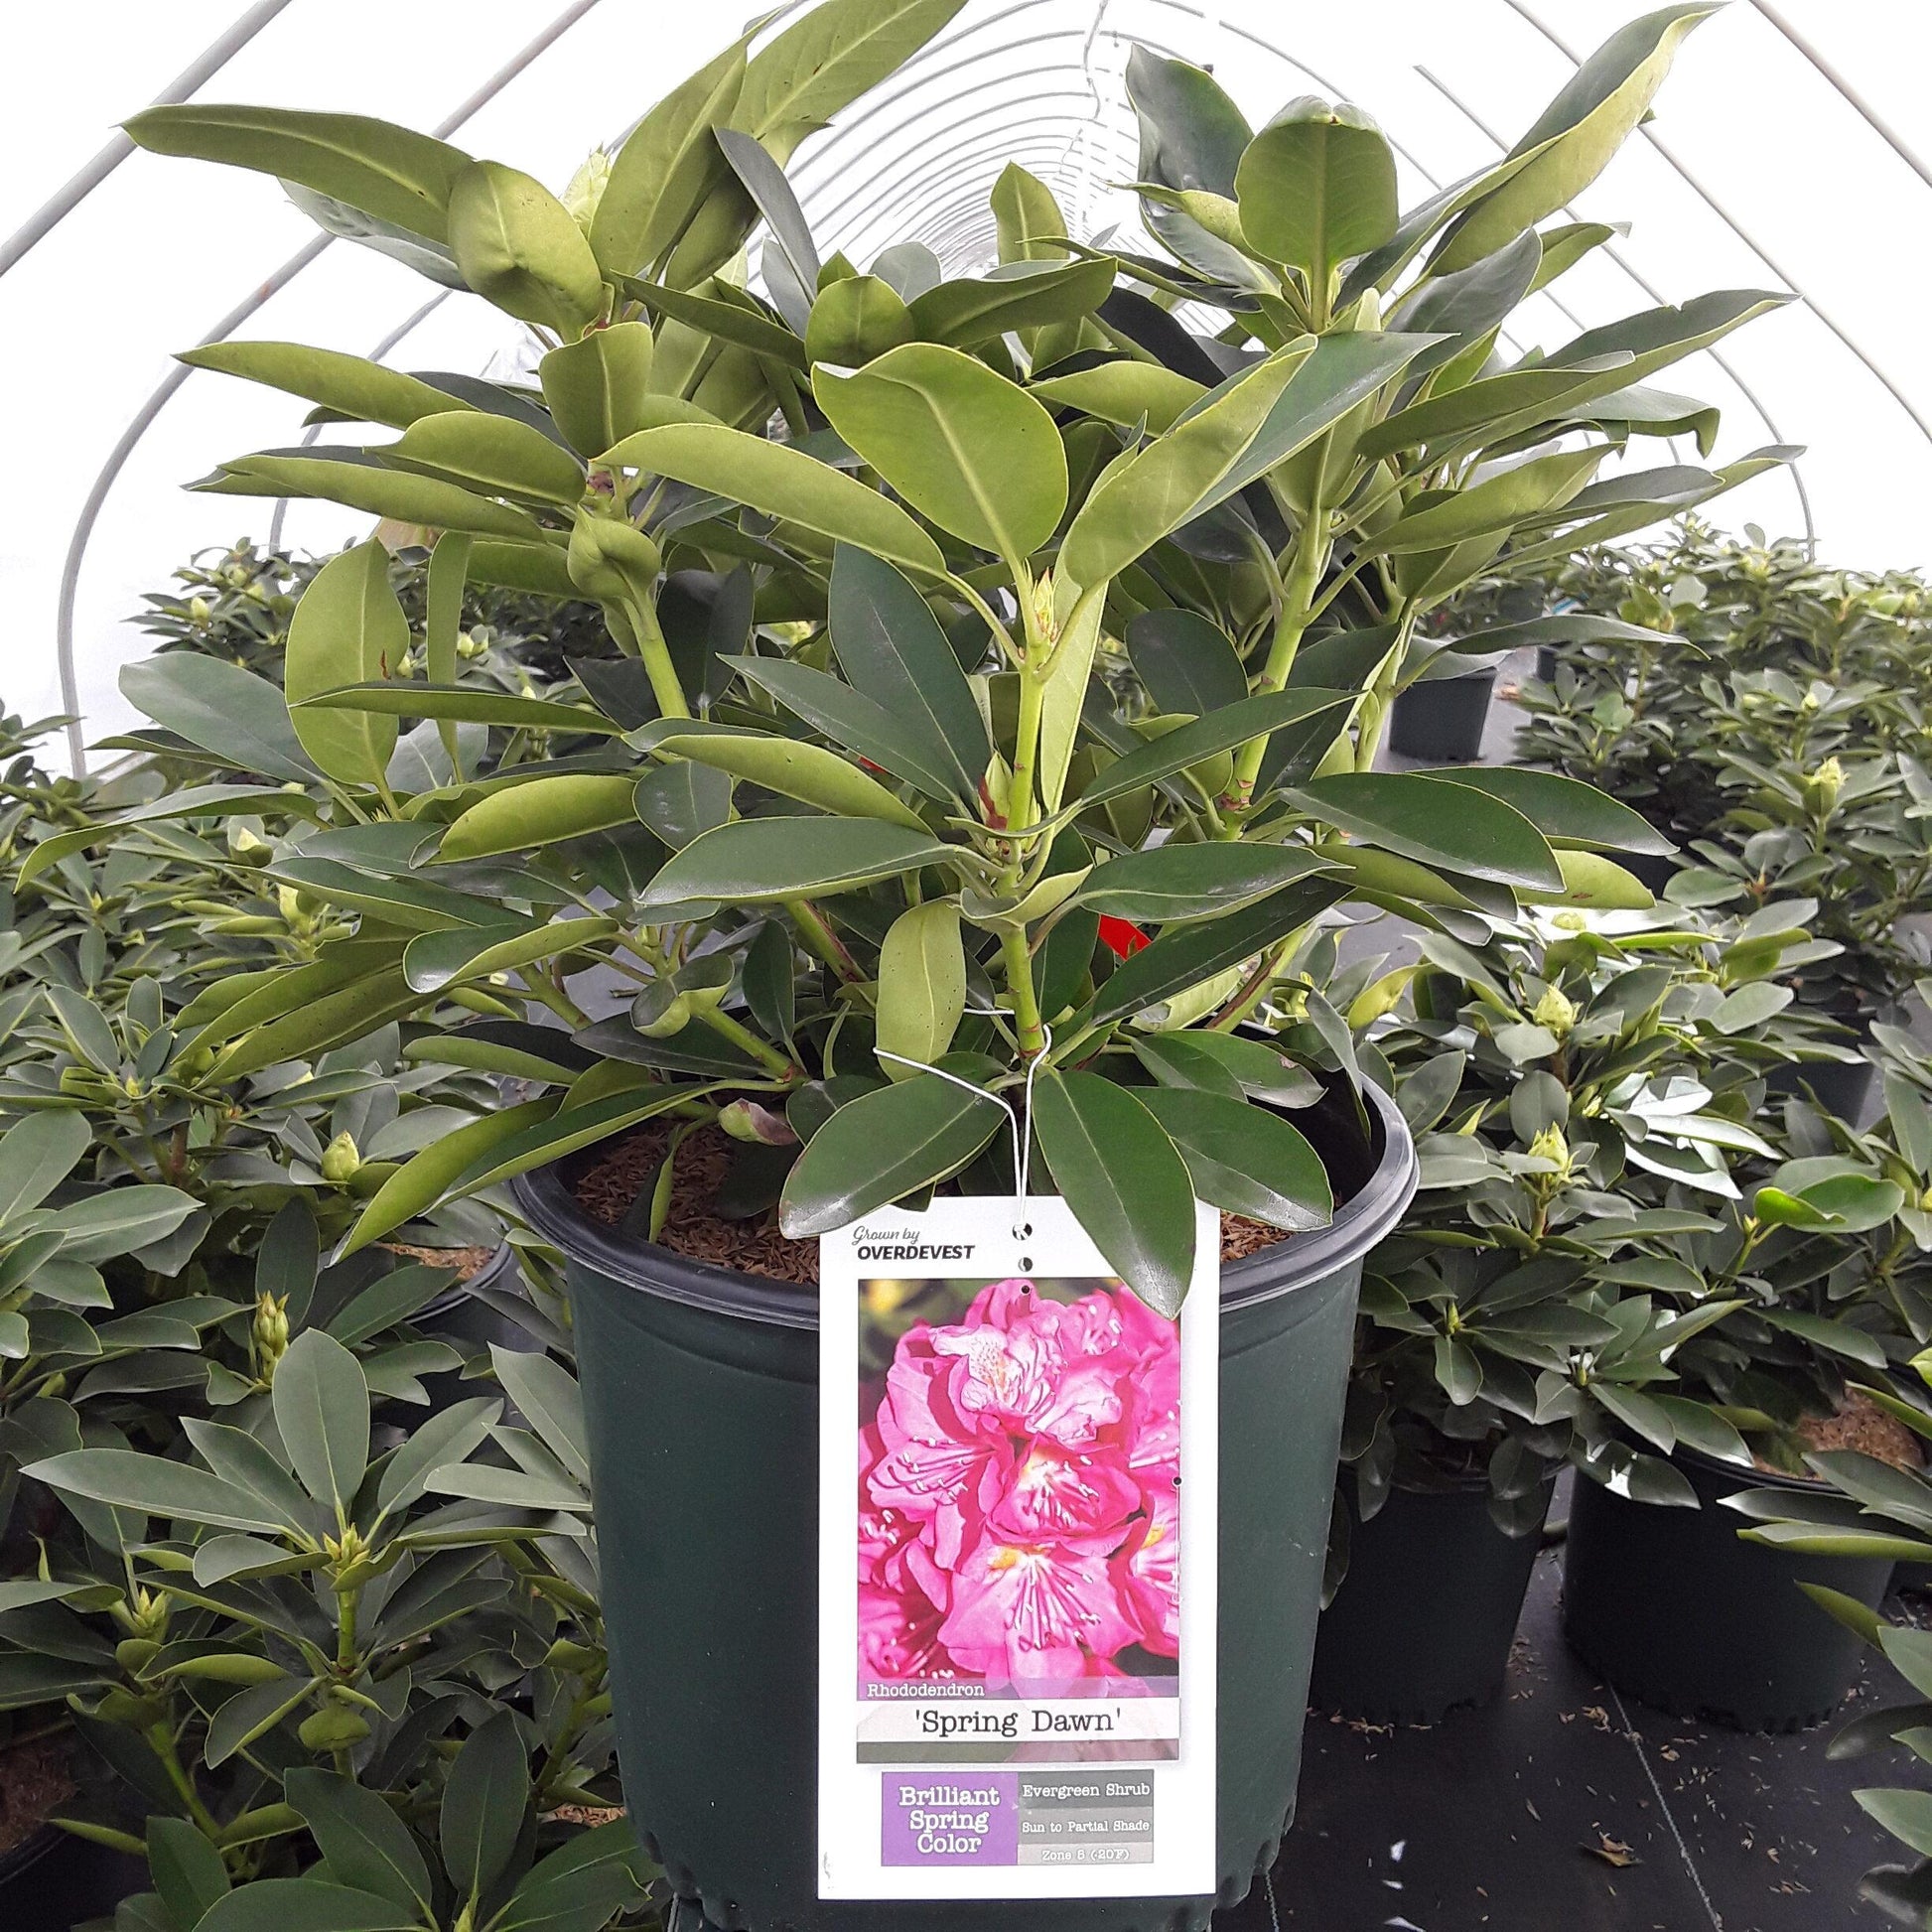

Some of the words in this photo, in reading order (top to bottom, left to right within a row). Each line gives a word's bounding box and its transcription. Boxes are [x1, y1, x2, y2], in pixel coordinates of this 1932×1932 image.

[852, 1225, 899, 1245] Grown
[902, 1227, 920, 1245] by
[857, 1245, 975, 1260] OVERDEVEST
[867, 1683, 985, 1698] Rhododendron
[915, 1709, 1019, 1737] 'Spring
[1032, 1707, 1121, 1732] Dawn'
[898, 1786, 1001, 1807] Brilliant
[1022, 1785, 1100, 1799] Evergreen
[1105, 1782, 1152, 1796] Shrub
[909, 1810, 990, 1834] Spring
[1022, 1821, 1045, 1834] Sun
[1050, 1821, 1062, 1833] to
[1067, 1821, 1109, 1833] Partial
[1113, 1820, 1151, 1832] Shade
[916, 1834, 982, 1855] Color
[1042, 1849, 1072, 1862] Zone
